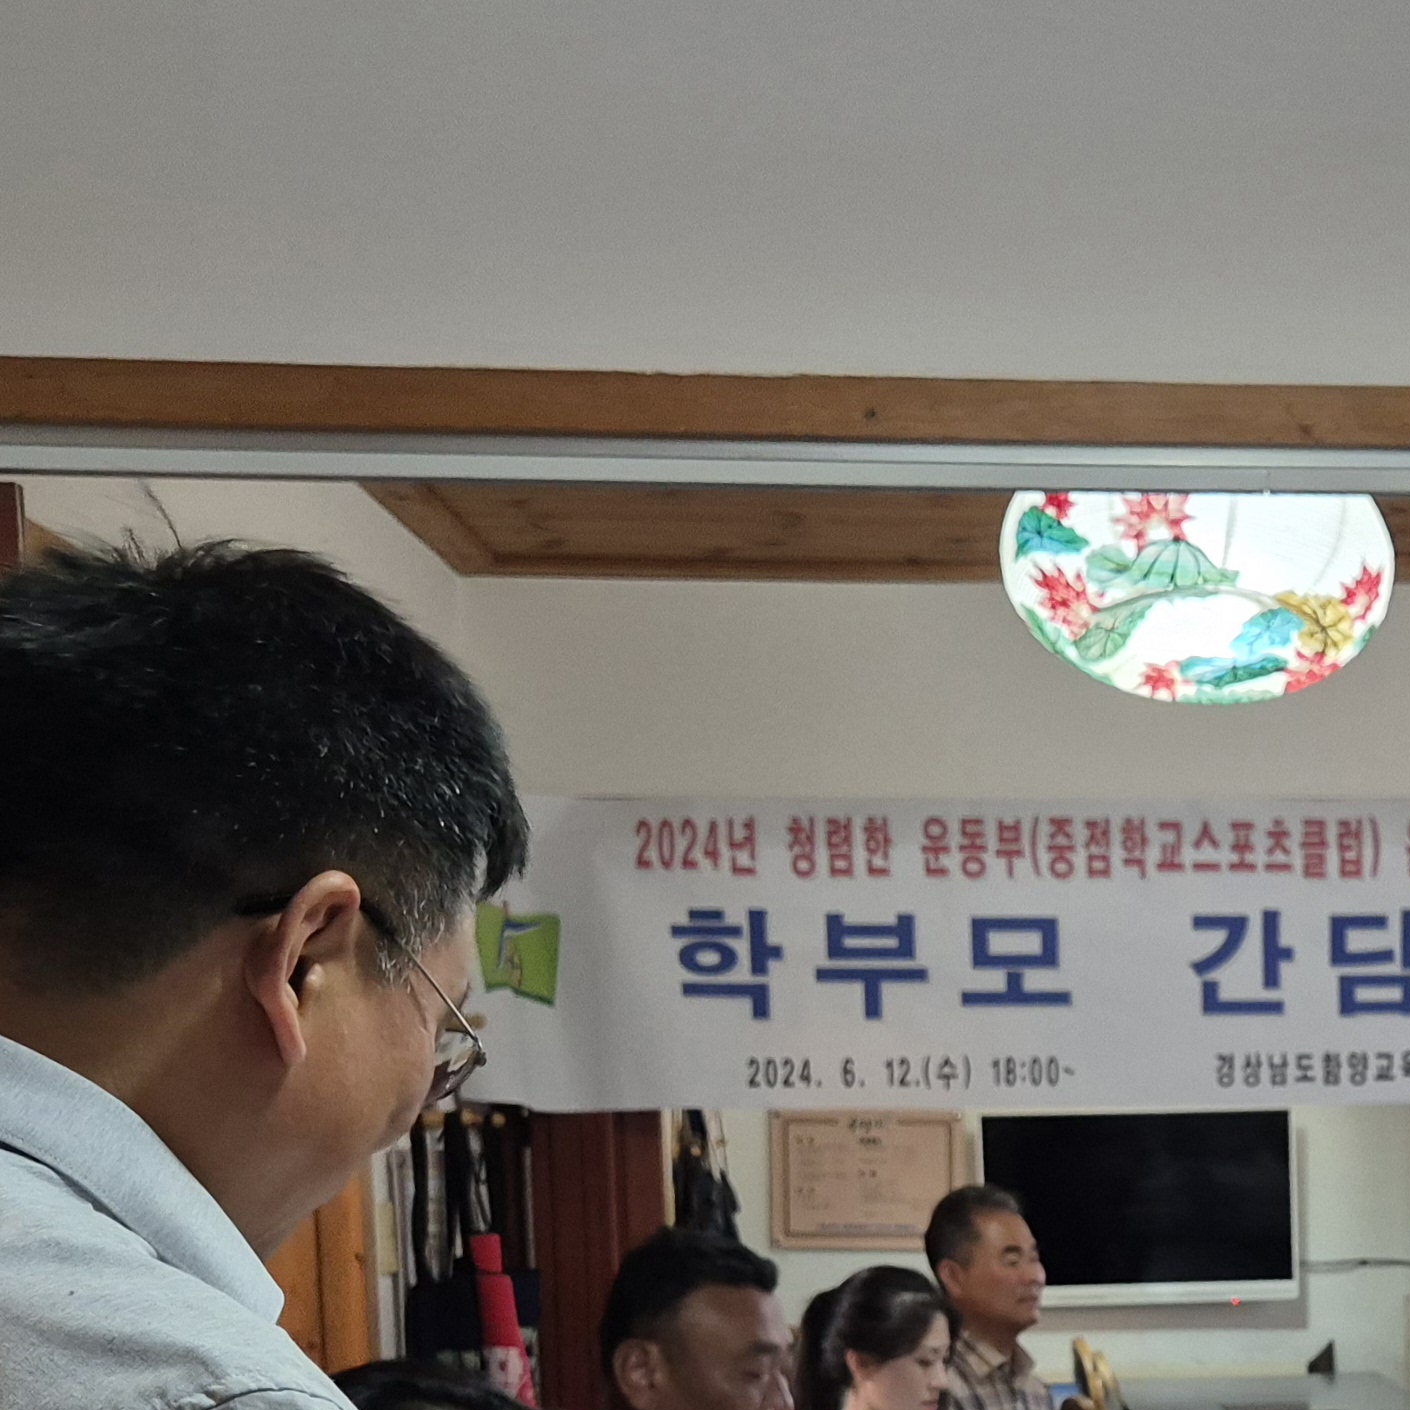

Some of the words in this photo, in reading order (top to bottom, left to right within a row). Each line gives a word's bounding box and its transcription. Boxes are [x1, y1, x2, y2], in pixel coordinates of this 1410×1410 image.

[635, 817, 758, 878] 2024년
[787, 817, 893, 879] 청렴한
[921, 817, 1382, 880] 운동부(중점학교스포츠클럽)
[671, 908, 1073, 1021] 학부모
[747, 1056, 822, 1089] 2024.
[841, 1057, 866, 1089] 6.
[885, 1055, 972, 1090] 12.(수)
